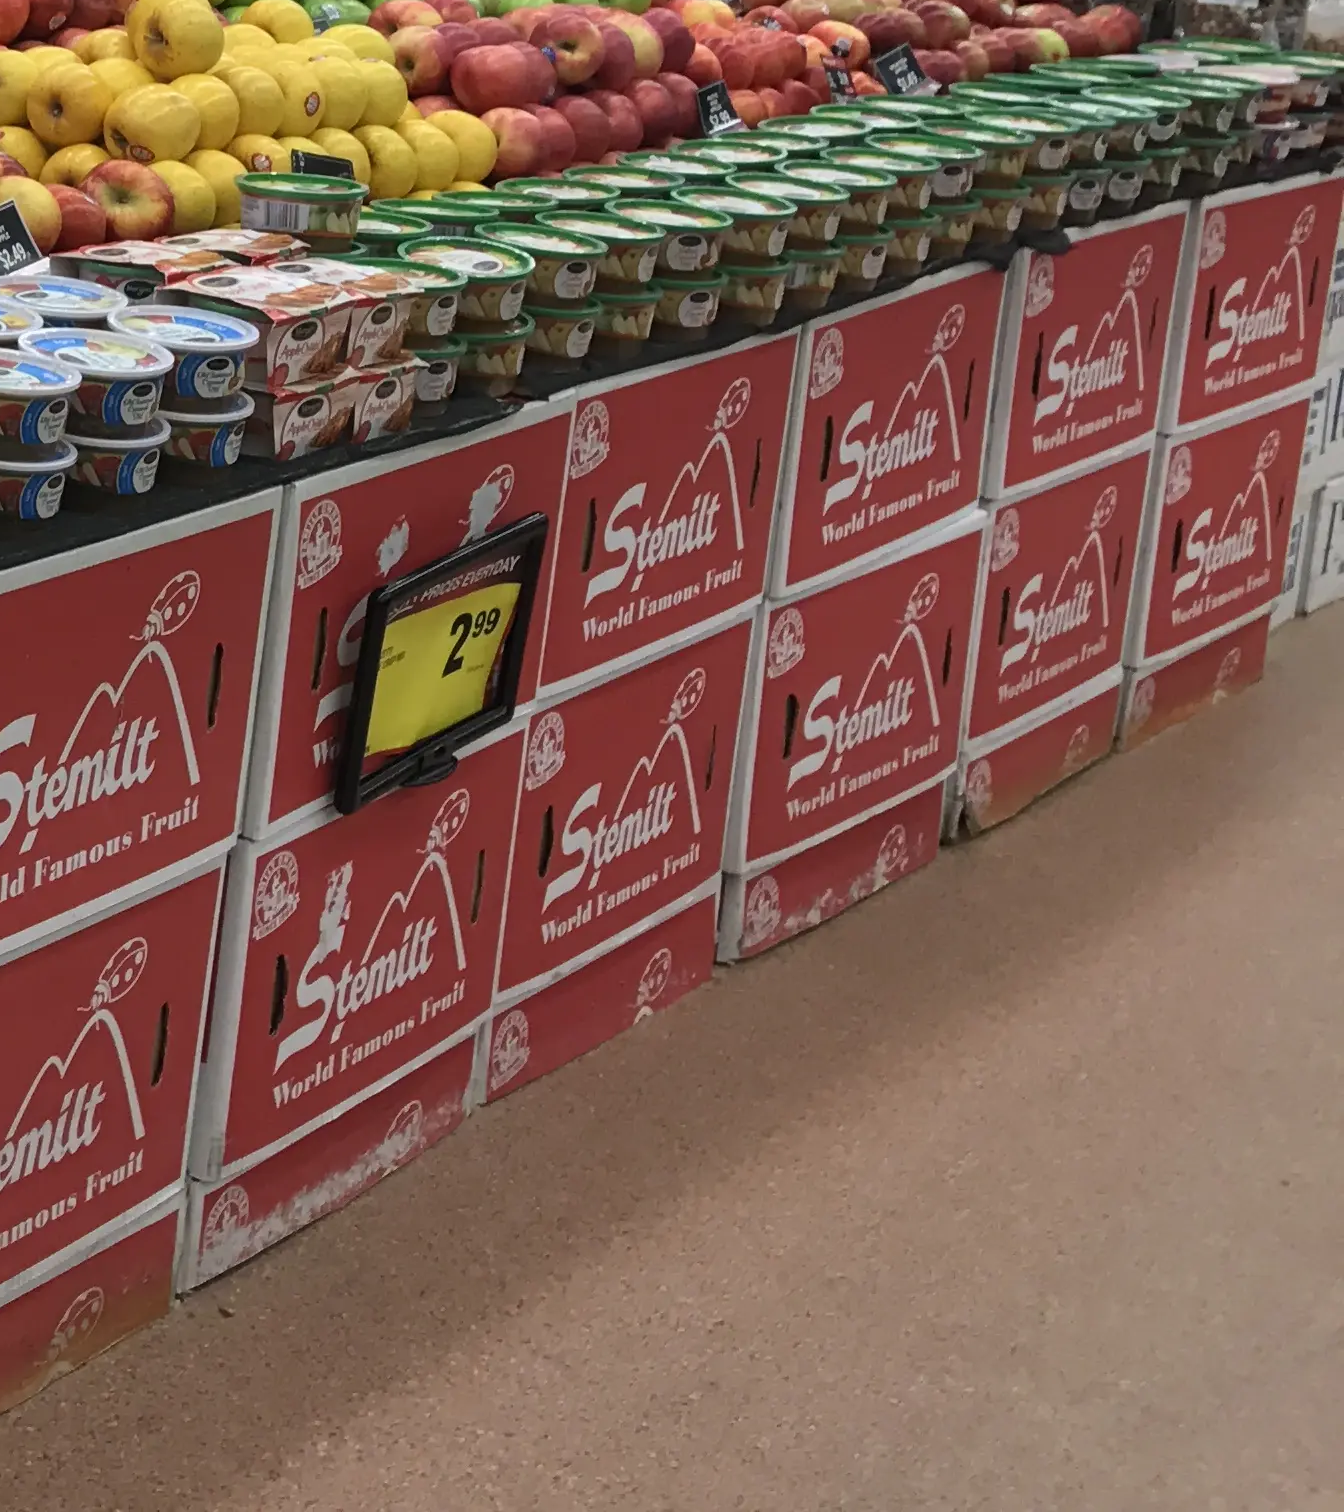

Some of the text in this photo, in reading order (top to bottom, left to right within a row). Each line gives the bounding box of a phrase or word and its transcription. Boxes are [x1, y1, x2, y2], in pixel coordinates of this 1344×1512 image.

[1206, 277, 1291, 369] Stemilt
[1034, 324, 1129, 426] Stemilt
[822, 470, 960, 546] World Famous Fruit
[823, 399, 939, 516] Stemilt
[420, 554, 521, 603] PRICES EVERYDAY
[583, 483, 720, 609] Stemilt
[1173, 509, 1258, 601] Stemilt
[582, 558, 744, 642] World Famous Fruit
[1000, 573, 1093, 676] Stemilt
[785, 735, 940, 822] World Famous Fruit
[787, 675, 915, 789] Stemilt
[33, 828, 132, 888] Famous
[141, 794, 200, 839] Fruit
[541, 781, 676, 914] Stemilt
[541, 844, 701, 945] World Famous Fruit
[272, 980, 465, 1109] World Famous Fruit
[274, 918, 438, 1073] Stemilt
[86, 1148, 143, 1199] Fruit
